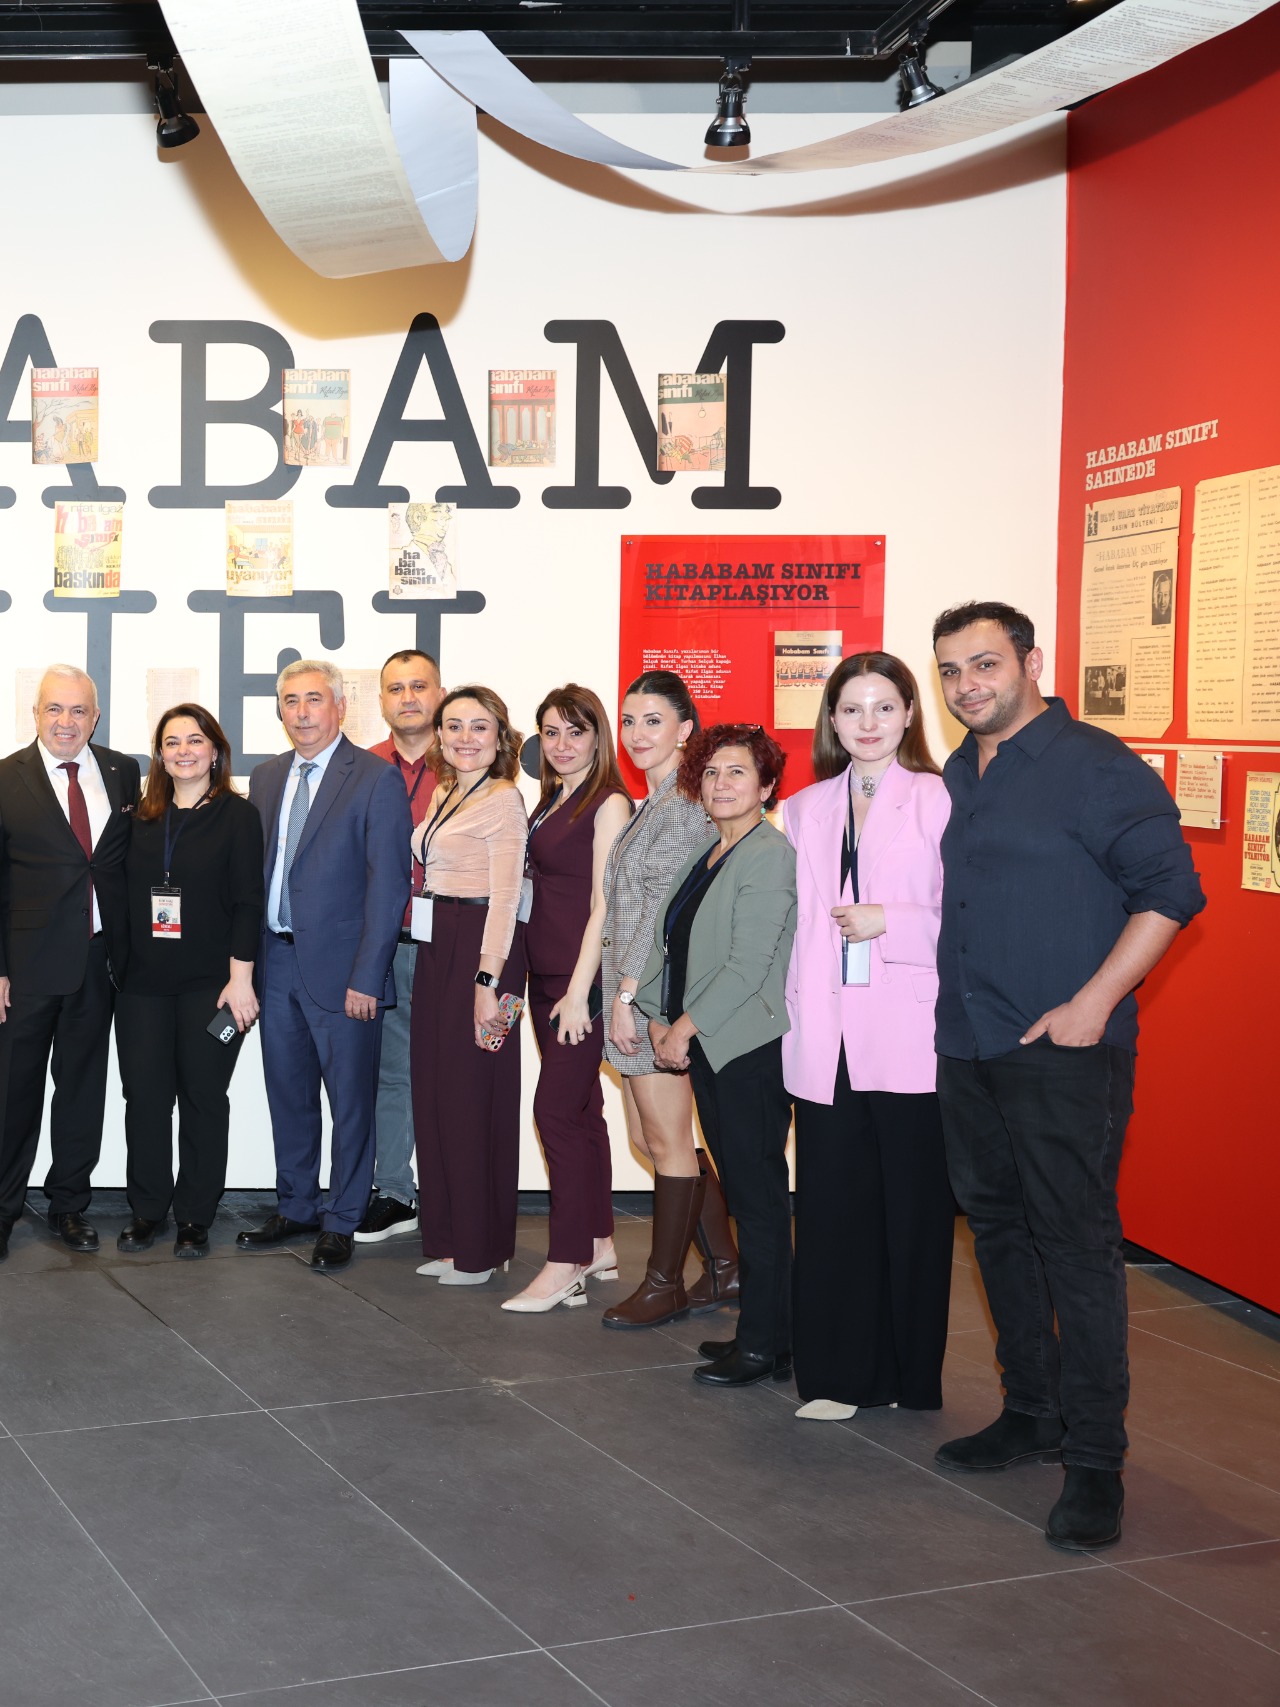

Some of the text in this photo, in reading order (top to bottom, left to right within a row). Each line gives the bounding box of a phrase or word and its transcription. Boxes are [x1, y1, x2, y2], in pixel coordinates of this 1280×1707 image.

[1086, 419, 1218, 469] HABABAM SINIFI
[1085, 459, 1156, 491] SAHNEDE
[1112, 524, 1128, 532] BASIN
[398, 558, 416, 567] ba
[403, 550, 420, 560] ha
[54, 567, 120, 588] baskında
[394, 566, 426, 576] bam
[645, 563, 861, 580] HABABAM SINIFI
[645, 579, 829, 606] KİTAPLAŞIYOR
